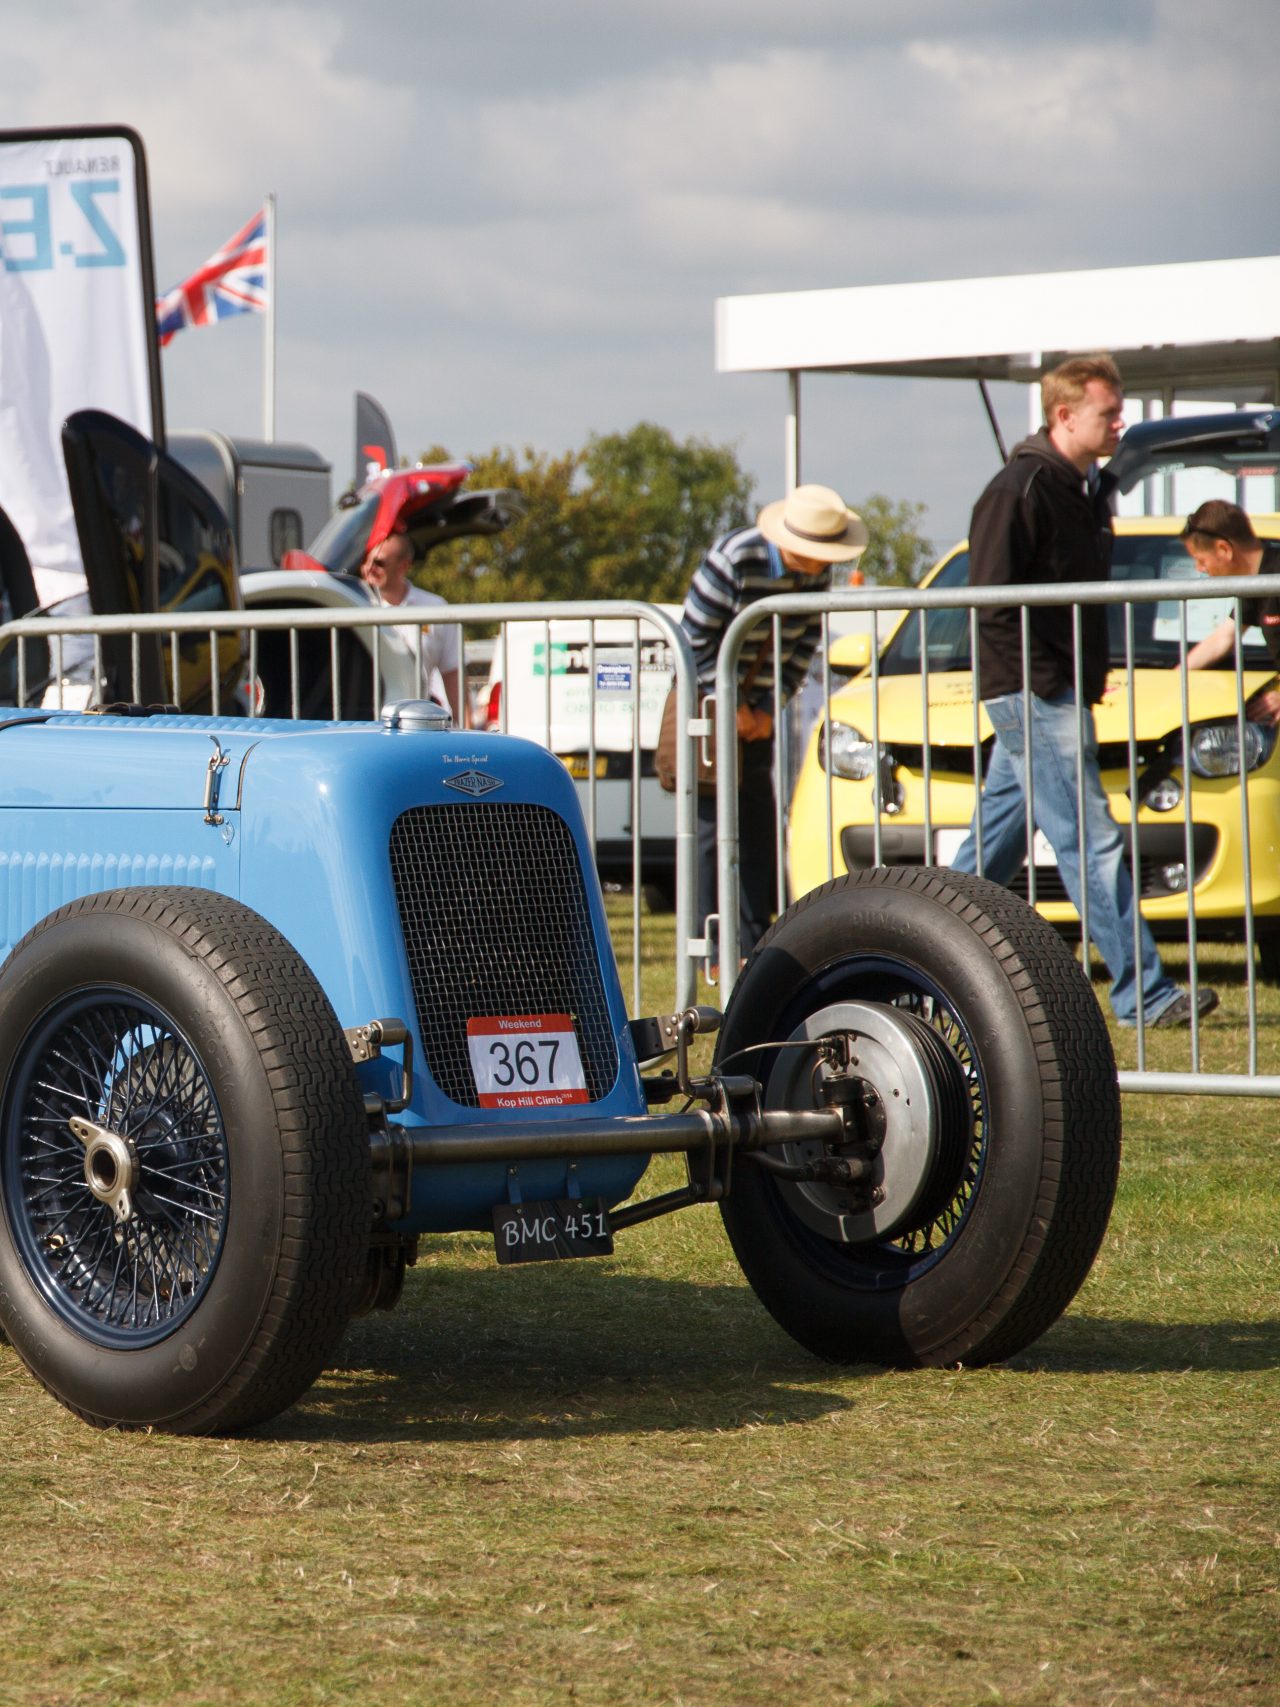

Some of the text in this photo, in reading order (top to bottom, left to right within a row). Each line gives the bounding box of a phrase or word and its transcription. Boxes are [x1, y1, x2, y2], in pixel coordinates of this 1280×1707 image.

[499, 1019, 542, 1029] Weekend
[489, 1040, 560, 1087] 367
[497, 1097, 517, 1108] Kop
[518, 1096, 534, 1106] Hill
[536, 1095, 563, 1105] Climb
[502, 1213, 607, 1246] BMC 451
